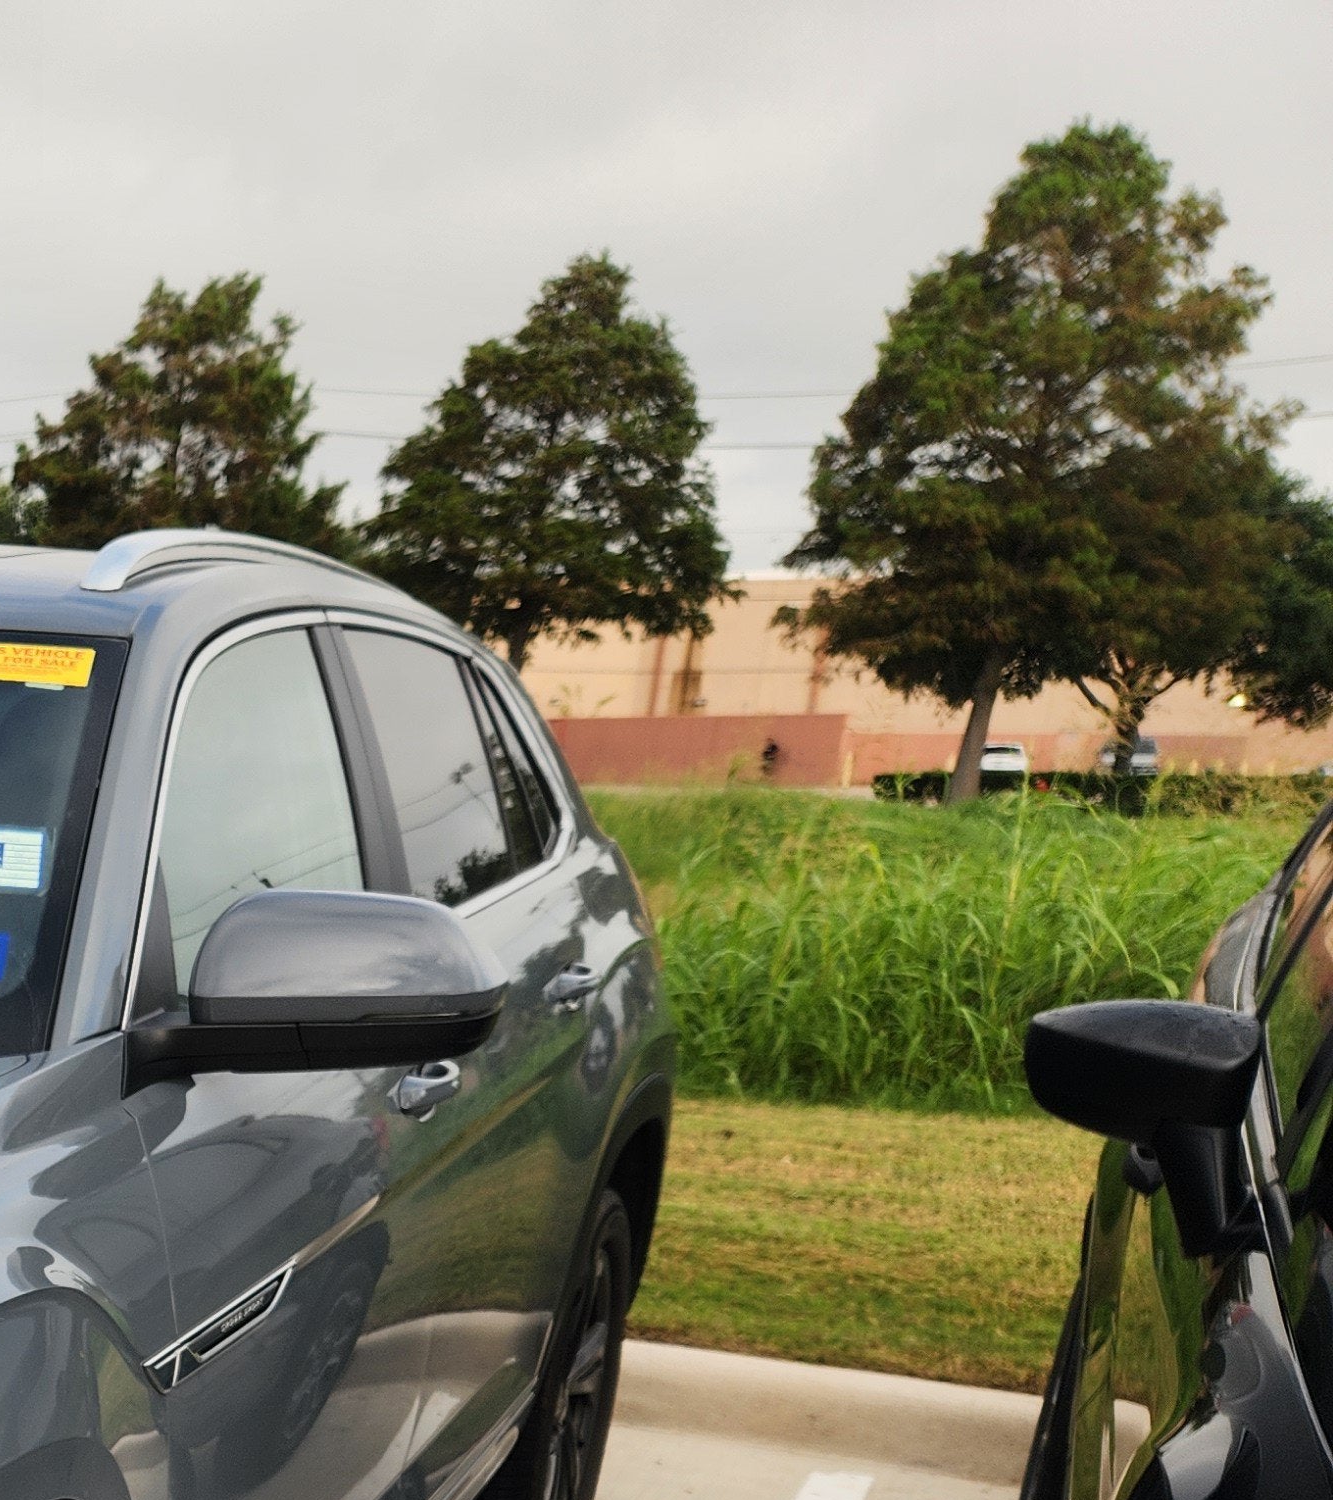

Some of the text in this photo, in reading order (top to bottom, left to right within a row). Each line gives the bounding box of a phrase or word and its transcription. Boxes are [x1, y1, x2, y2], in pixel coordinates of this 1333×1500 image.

[12, 648, 85, 660] VEHICLE
[4, 656, 33, 665] FOR
[39, 659, 79, 668] SALE
